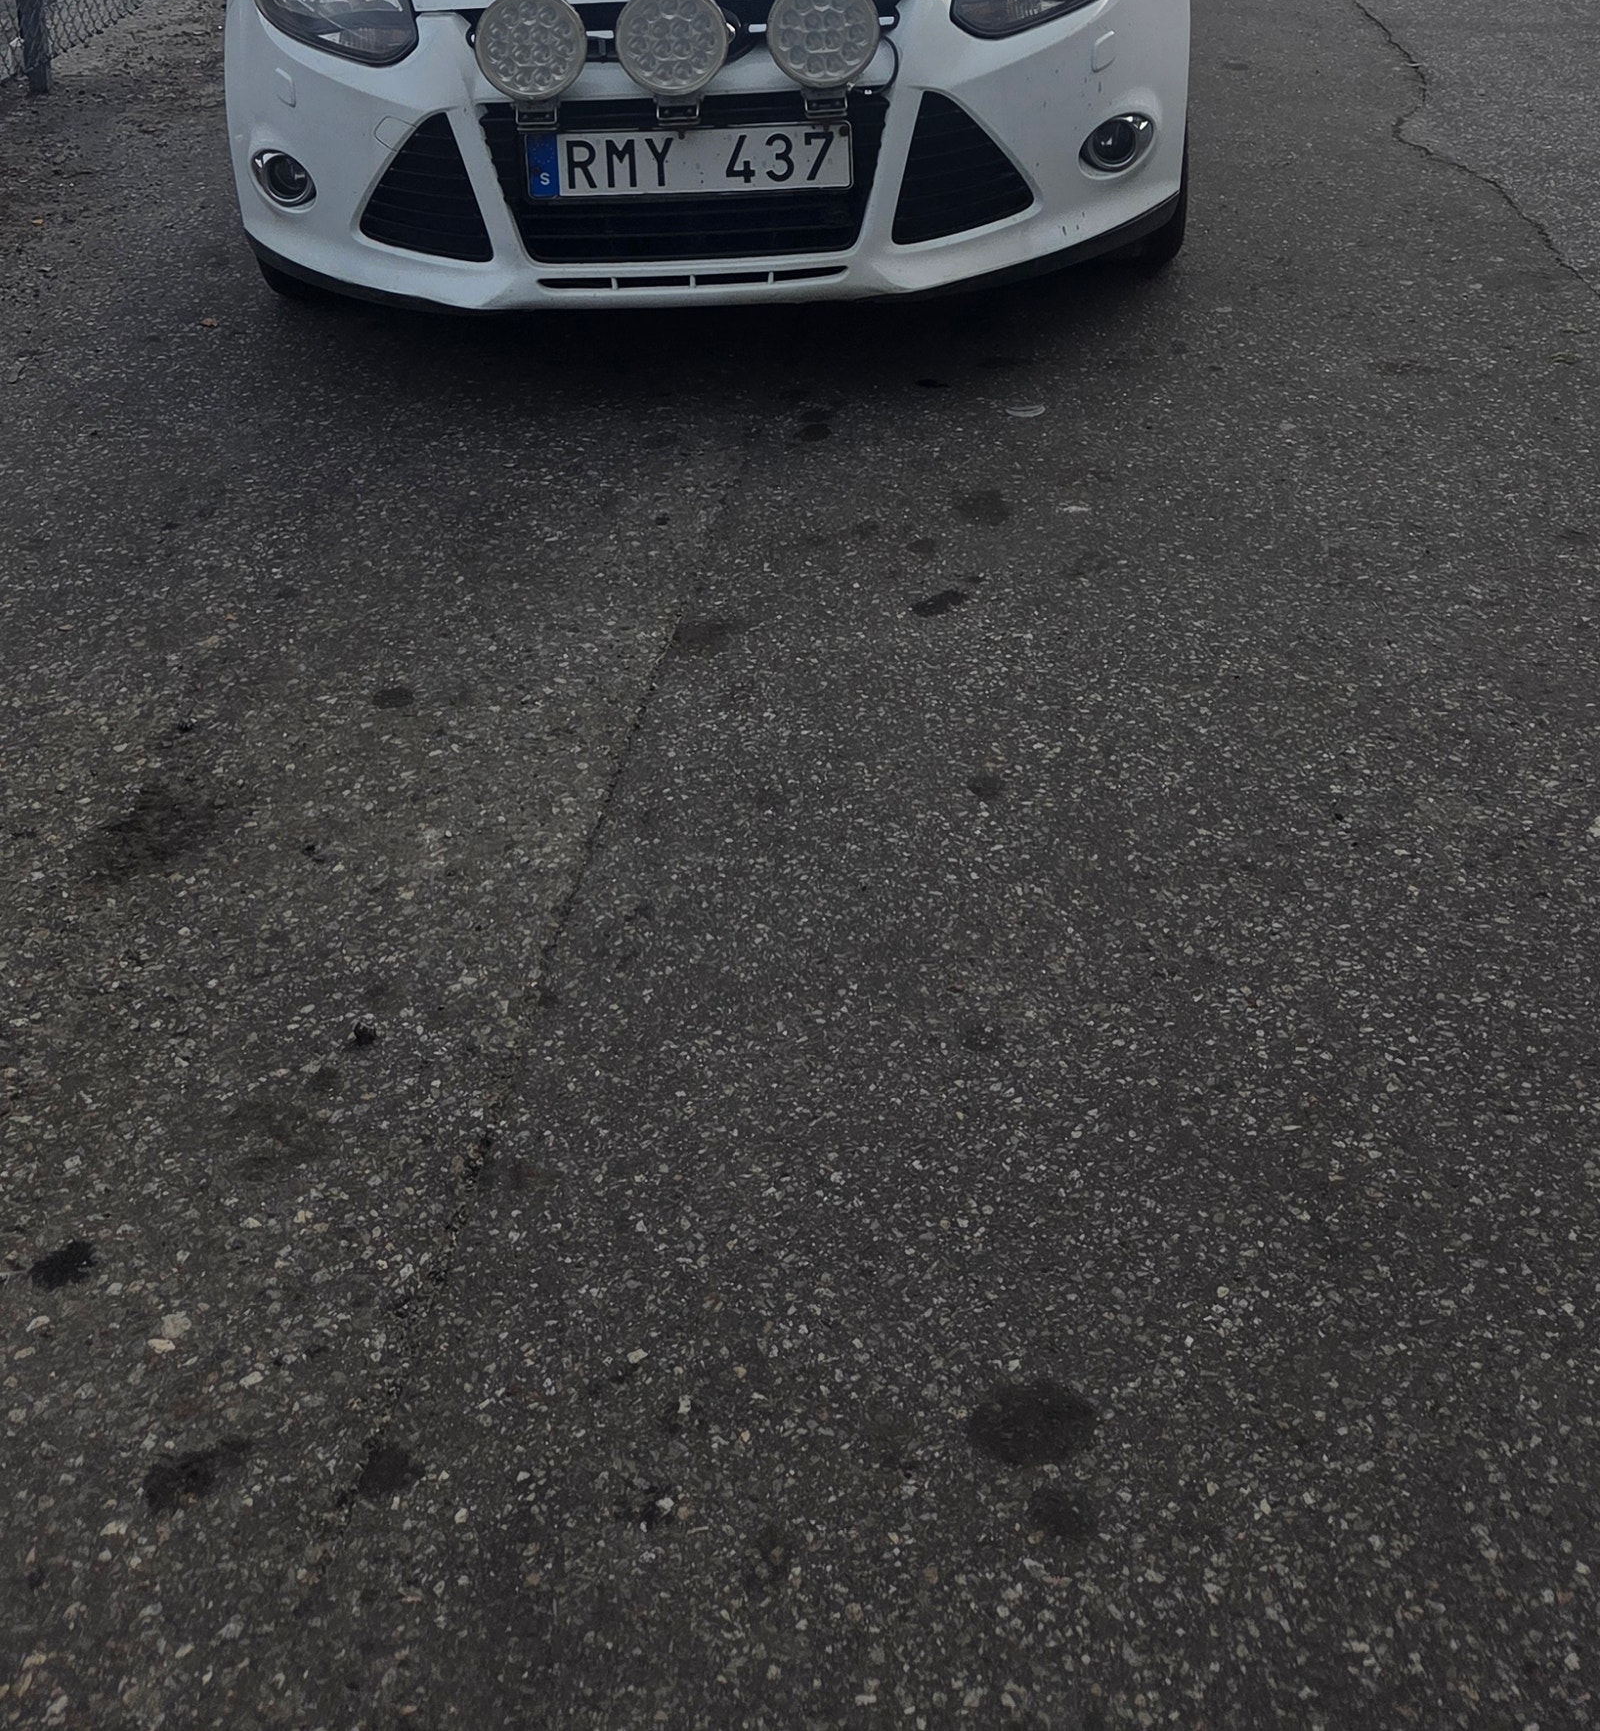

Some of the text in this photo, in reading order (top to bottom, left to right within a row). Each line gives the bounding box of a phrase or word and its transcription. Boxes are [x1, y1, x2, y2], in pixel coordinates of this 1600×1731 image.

[566, 131, 834, 189] RMY 437
[540, 172, 550, 185] S
